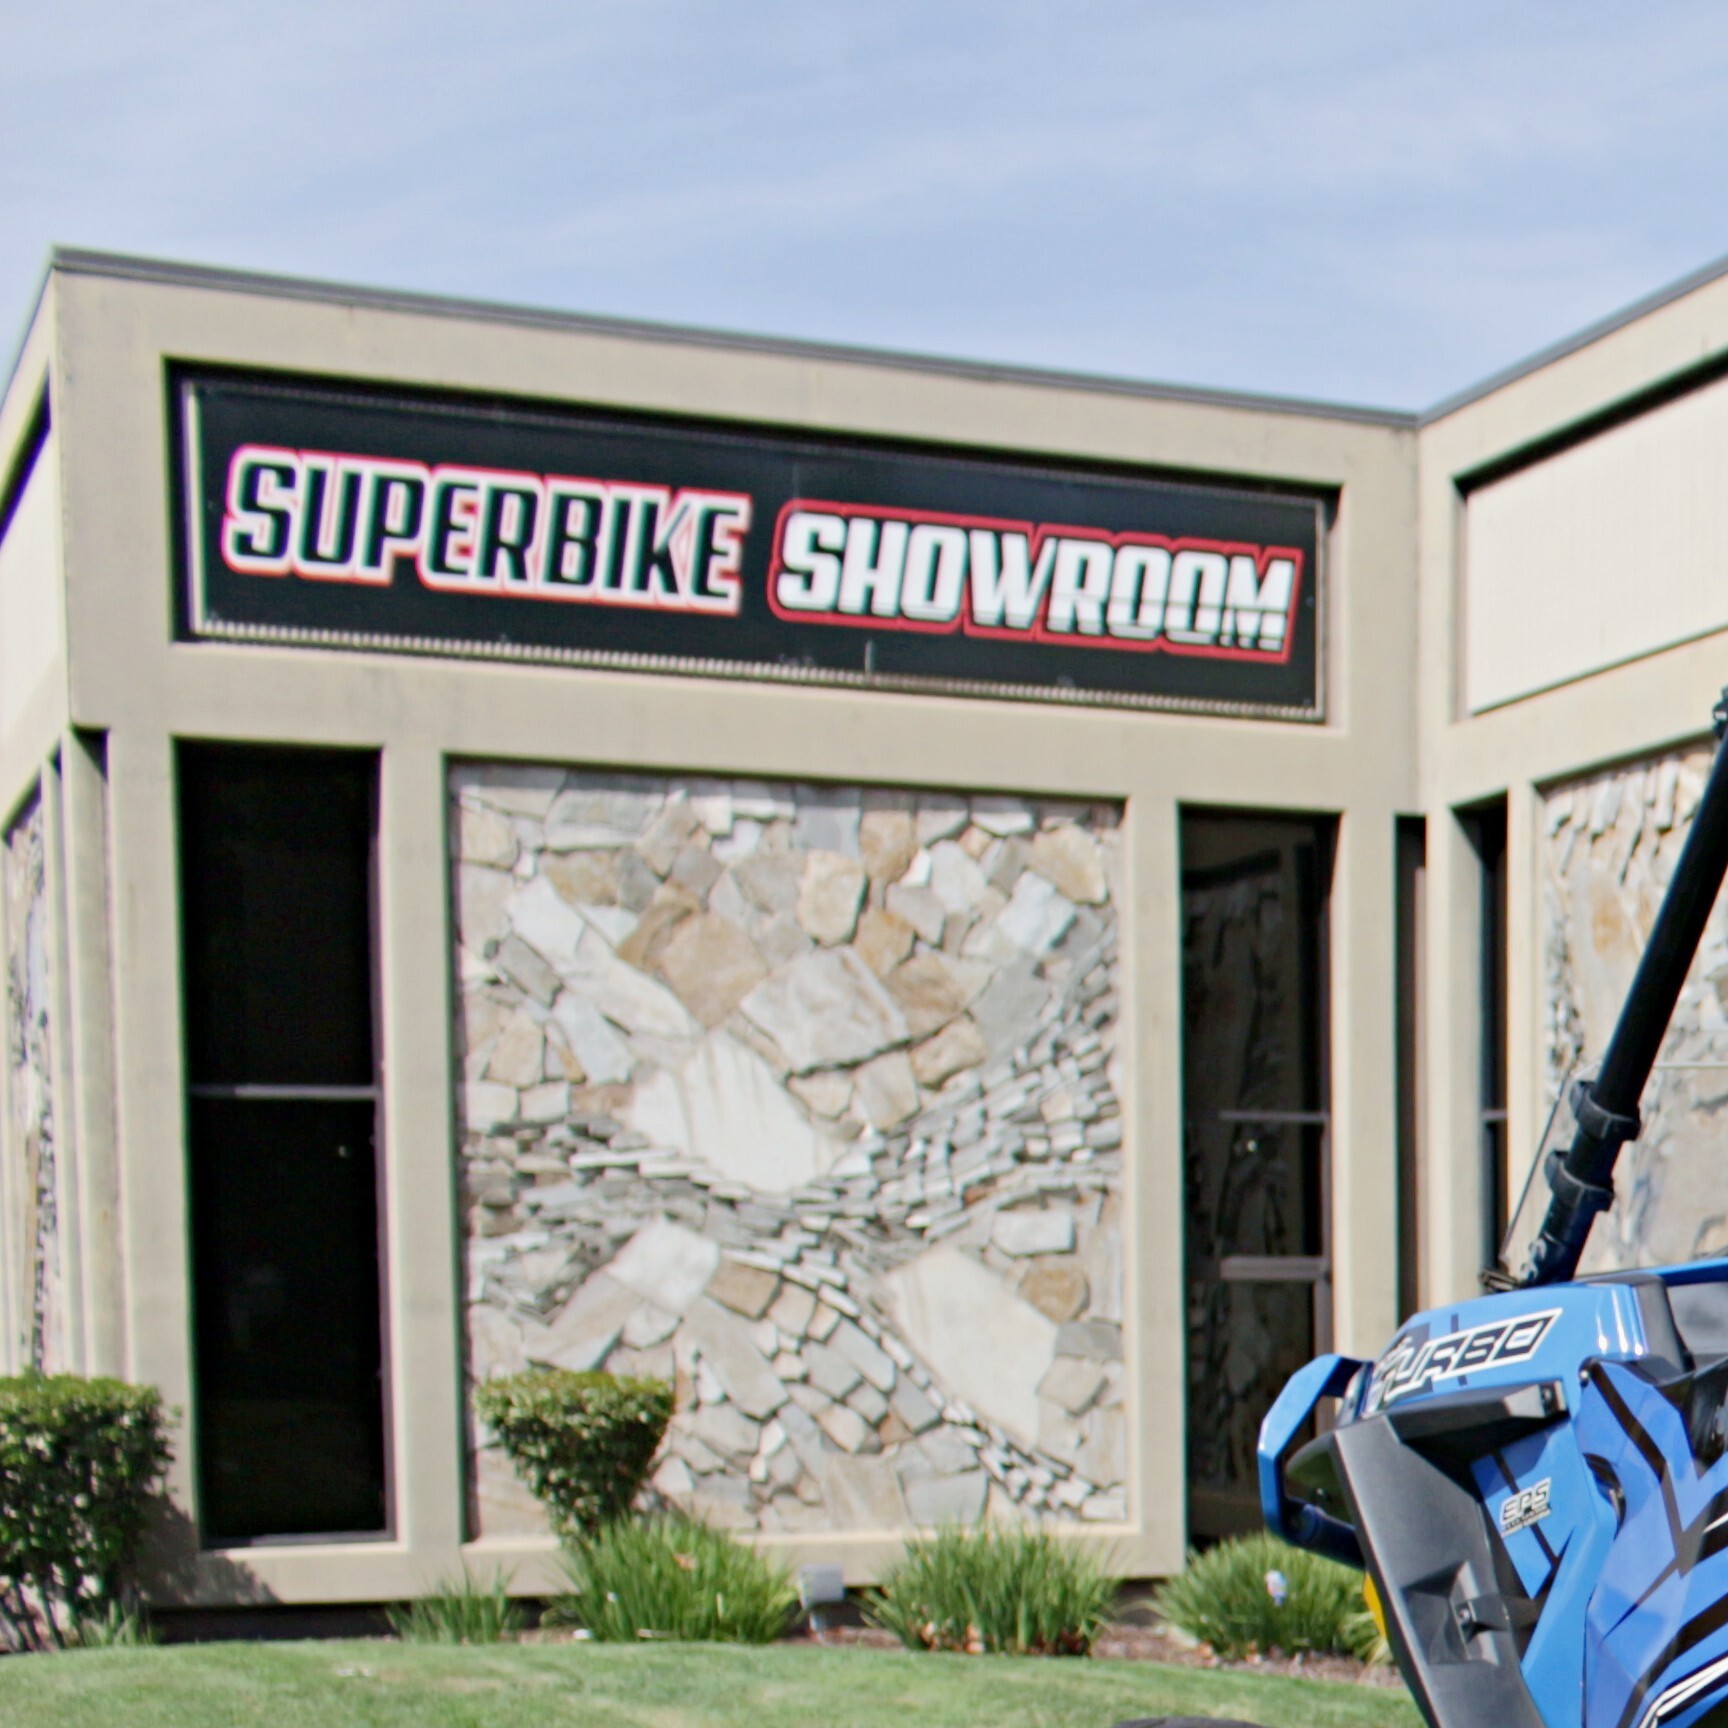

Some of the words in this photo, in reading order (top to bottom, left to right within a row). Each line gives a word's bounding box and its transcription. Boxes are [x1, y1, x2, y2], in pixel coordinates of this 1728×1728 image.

[226, 445, 750, 613] SUPERBIKE
[776, 505, 1299, 657] SHOWROOM
[1500, 1477, 1551, 1522] EPS
